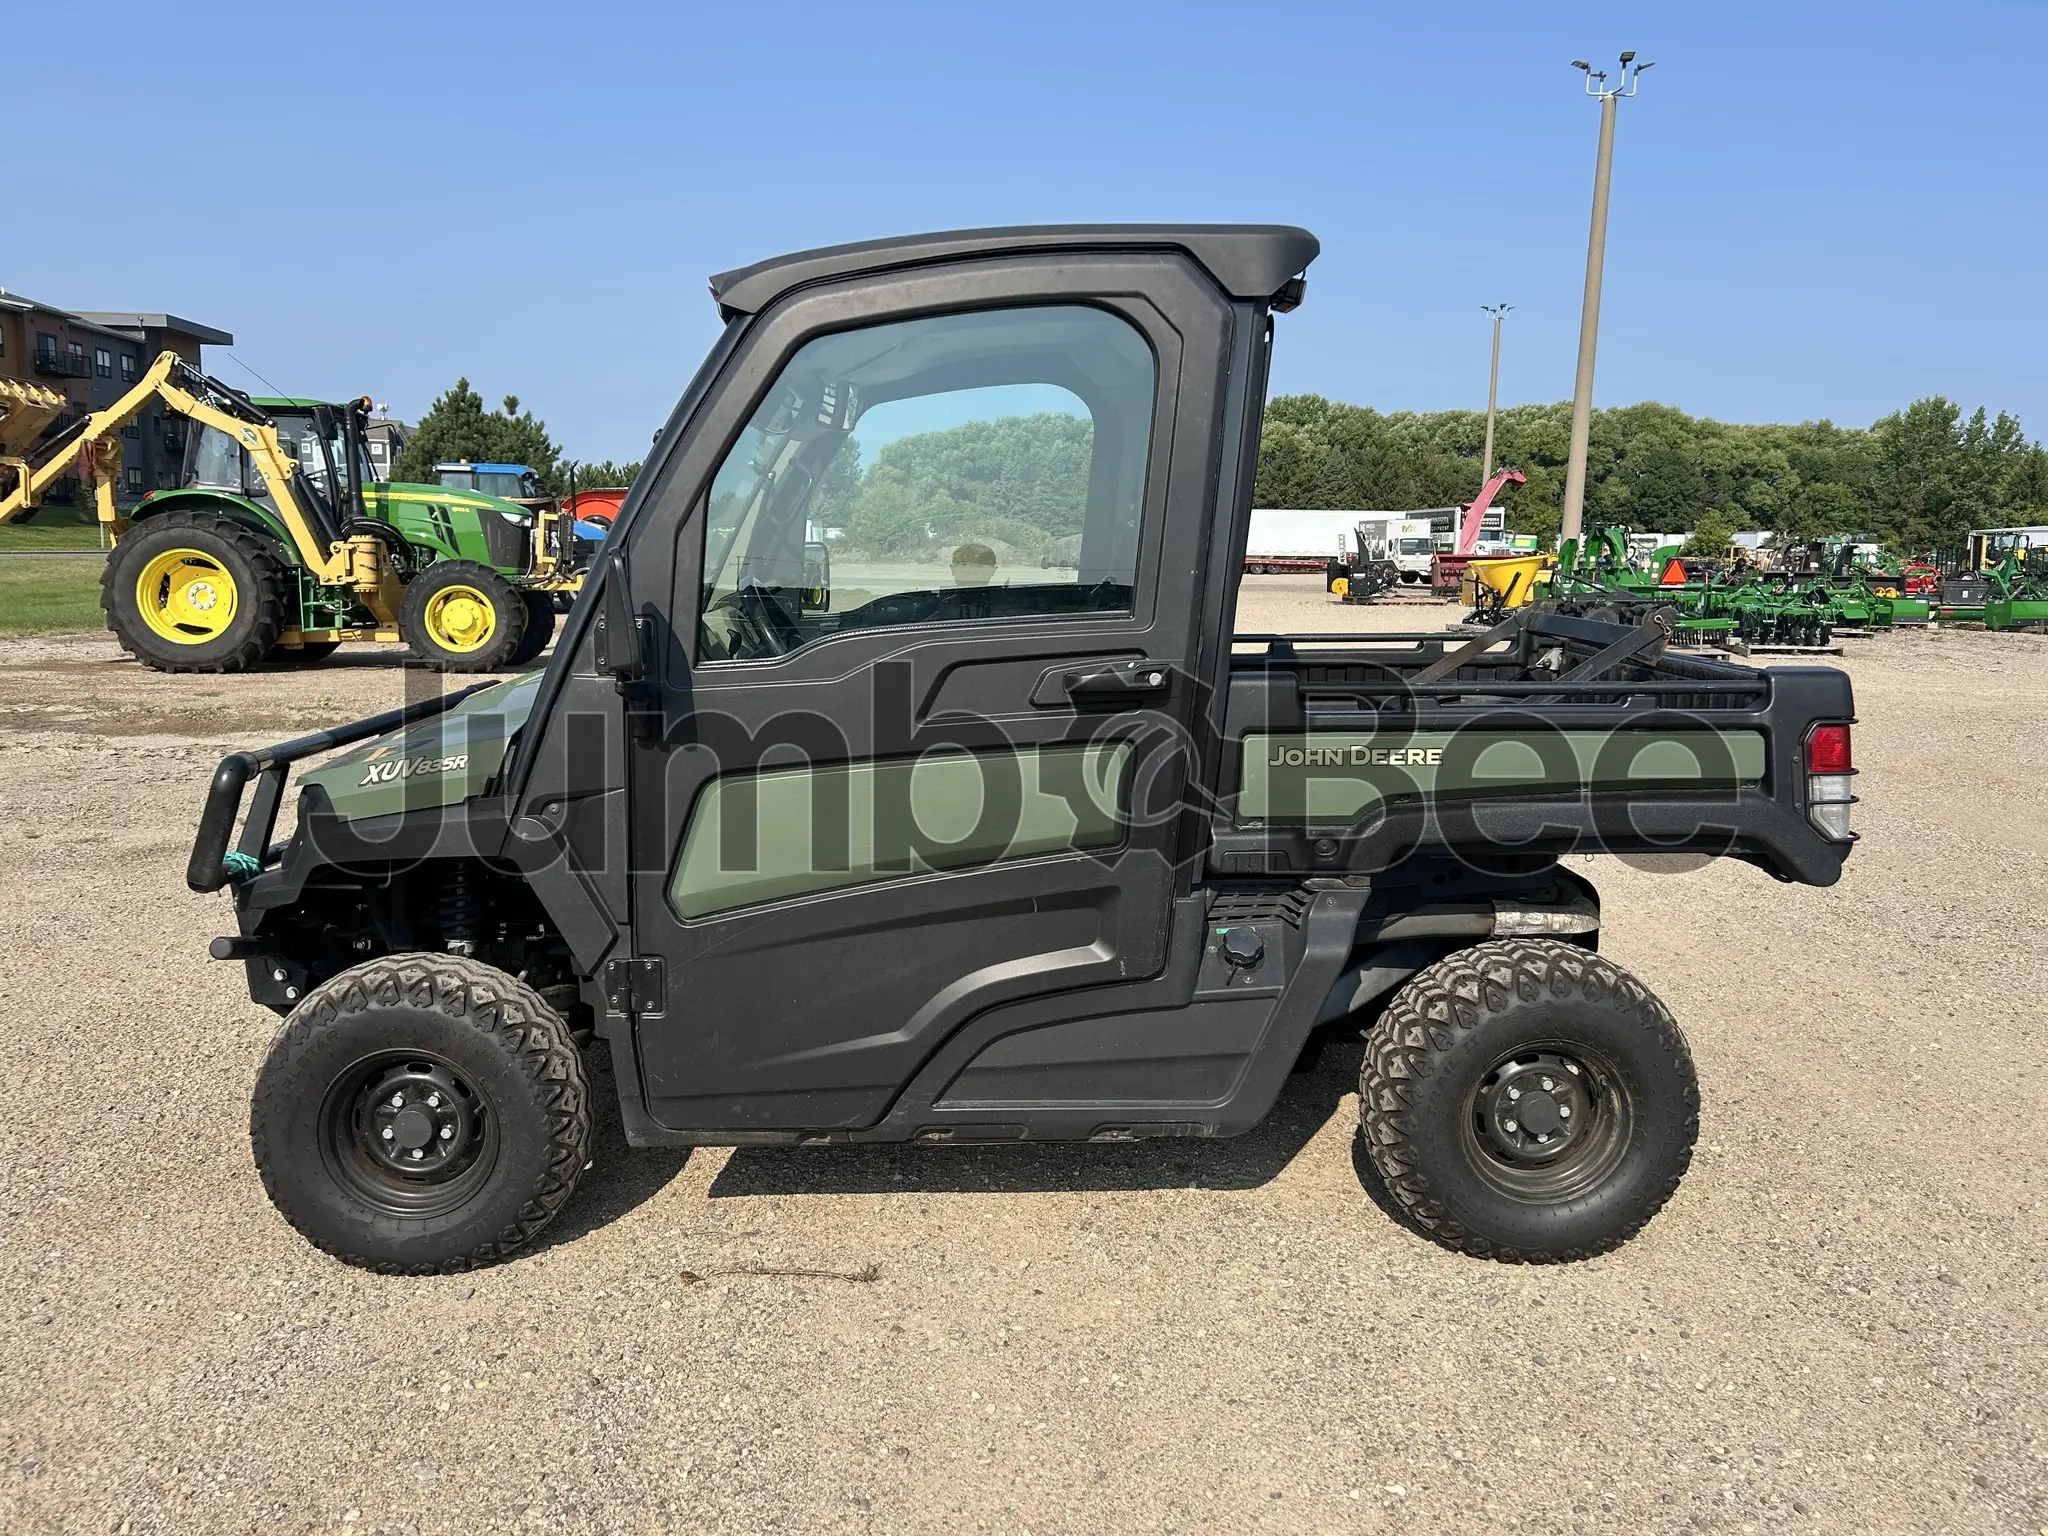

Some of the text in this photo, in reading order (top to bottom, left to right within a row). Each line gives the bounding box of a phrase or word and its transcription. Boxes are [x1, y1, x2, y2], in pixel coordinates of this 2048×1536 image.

[1269, 745, 1443, 767] JOHN DEERE
[357, 754, 469, 787] XUV835R
